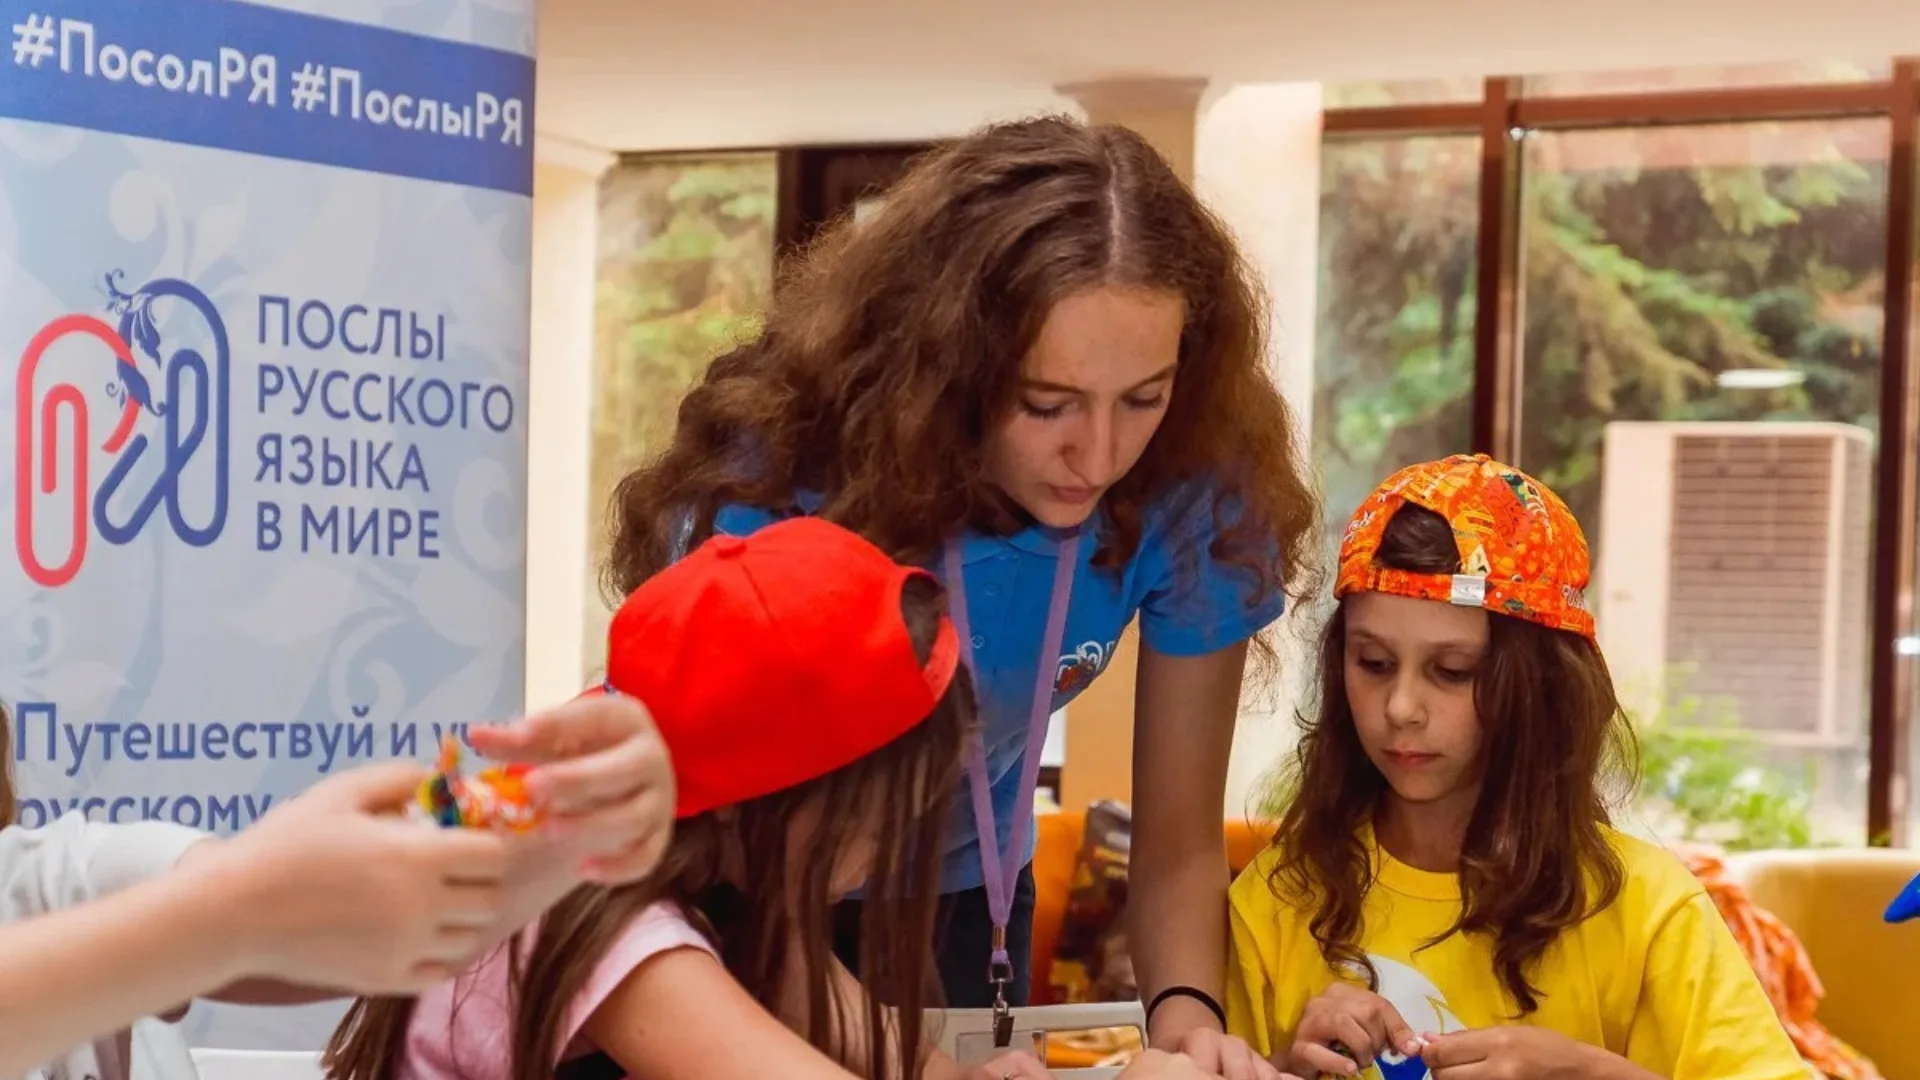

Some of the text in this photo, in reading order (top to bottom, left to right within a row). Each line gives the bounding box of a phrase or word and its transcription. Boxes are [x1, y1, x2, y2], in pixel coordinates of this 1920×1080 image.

[12, 13, 524, 146] #ПосолРЯ #ПослыРЯ
[257, 295, 445, 361] ПОСЛЫ
[257, 364, 514, 433] РУССКОГО
[254, 433, 430, 492] ЯЗЫКА
[256, 501, 440, 559] В МИРЕ
[15, 702, 374, 777] Путешествуй
[390, 721, 417, 757] и
